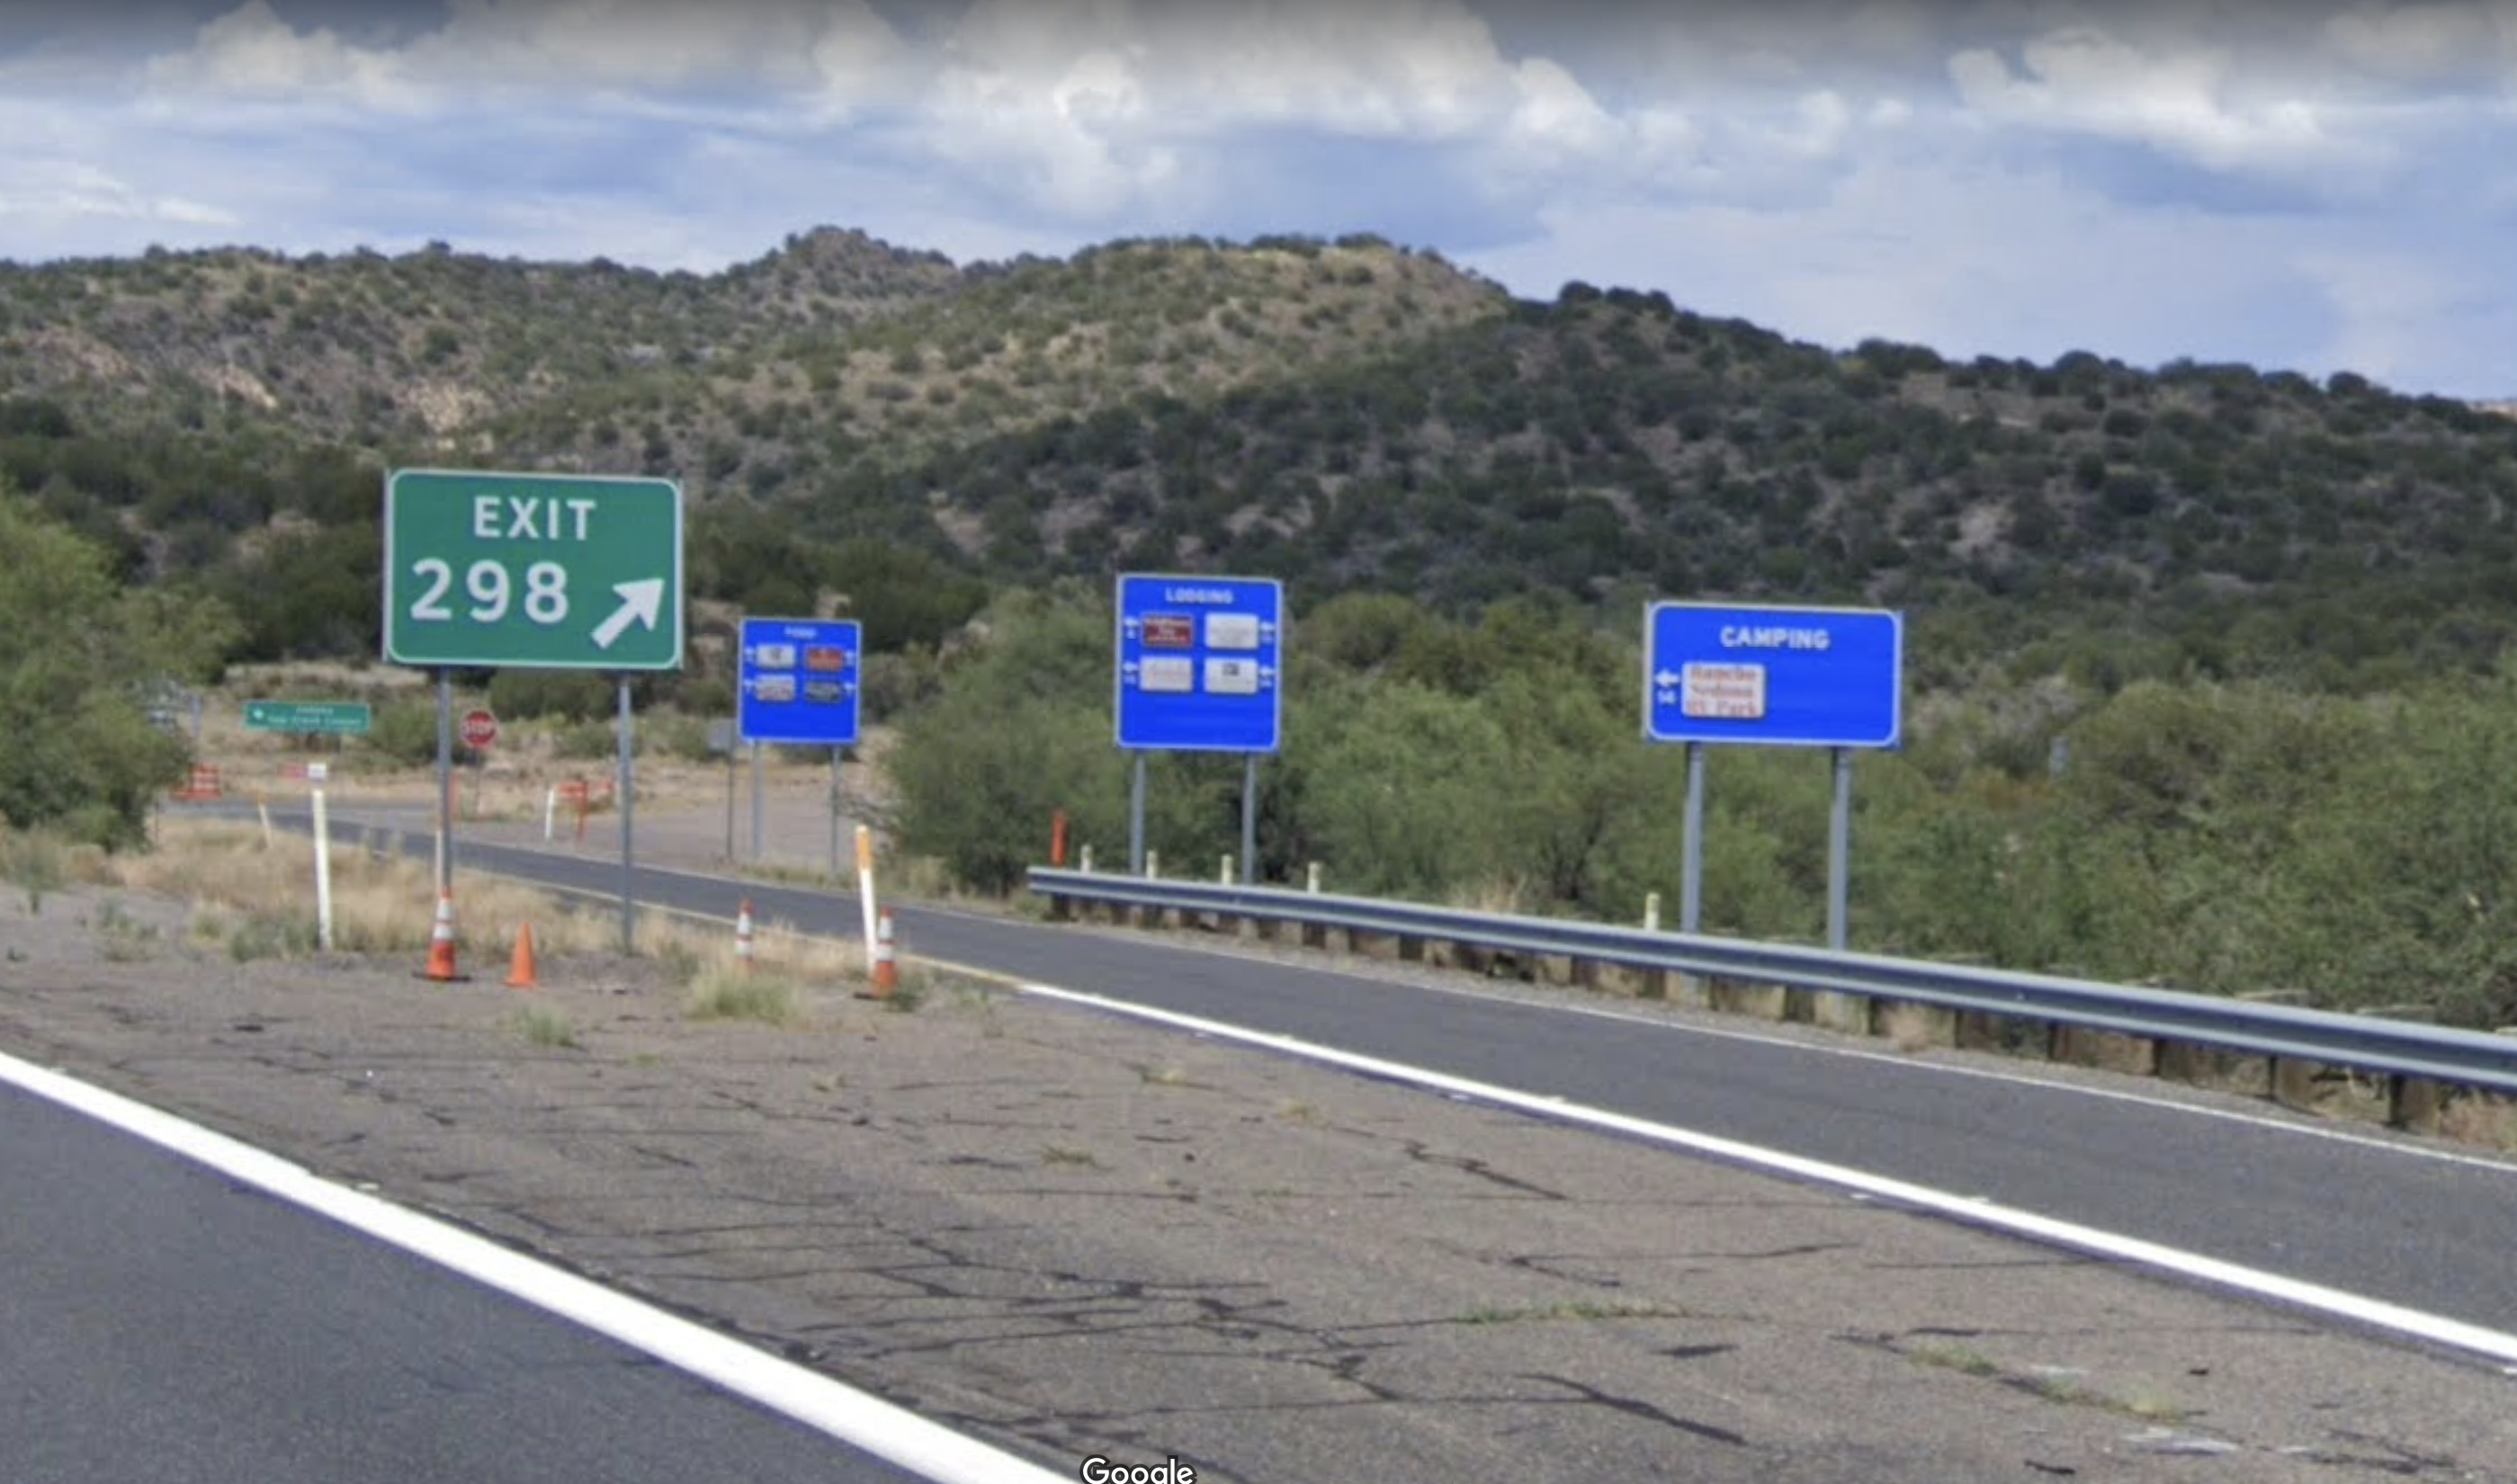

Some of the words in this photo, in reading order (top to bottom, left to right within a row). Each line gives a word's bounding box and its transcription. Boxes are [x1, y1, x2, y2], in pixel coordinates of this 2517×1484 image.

[473, 496, 596, 540] EXIT
[410, 558, 569, 623] 298
[1719, 626, 1831, 650] CAMPING
[461, 720, 495, 737] STOP
